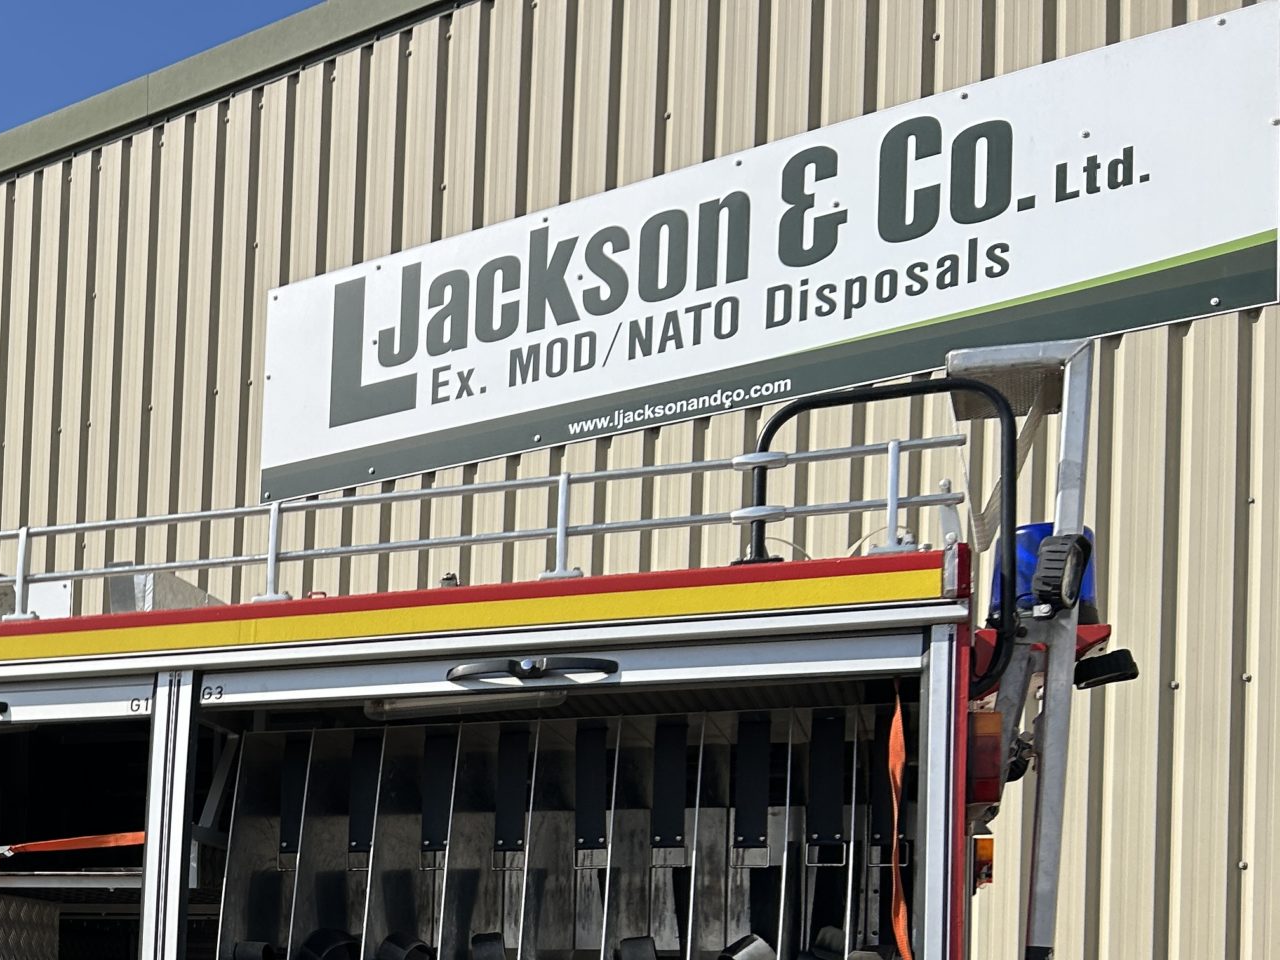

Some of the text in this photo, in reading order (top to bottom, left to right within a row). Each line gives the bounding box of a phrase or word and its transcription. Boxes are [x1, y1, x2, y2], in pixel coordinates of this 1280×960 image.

[778, 146, 848, 267] &
[878, 115, 1036, 243] Co.
[1055, 146, 1151, 203] Ltd.
[431, 237, 1010, 405] Ex. MOD/NATO Disposals
[568, 378, 791, 435] www.ljacksonandco.com
[130, 697, 149, 712] G1
[202, 686, 224, 700] G3
